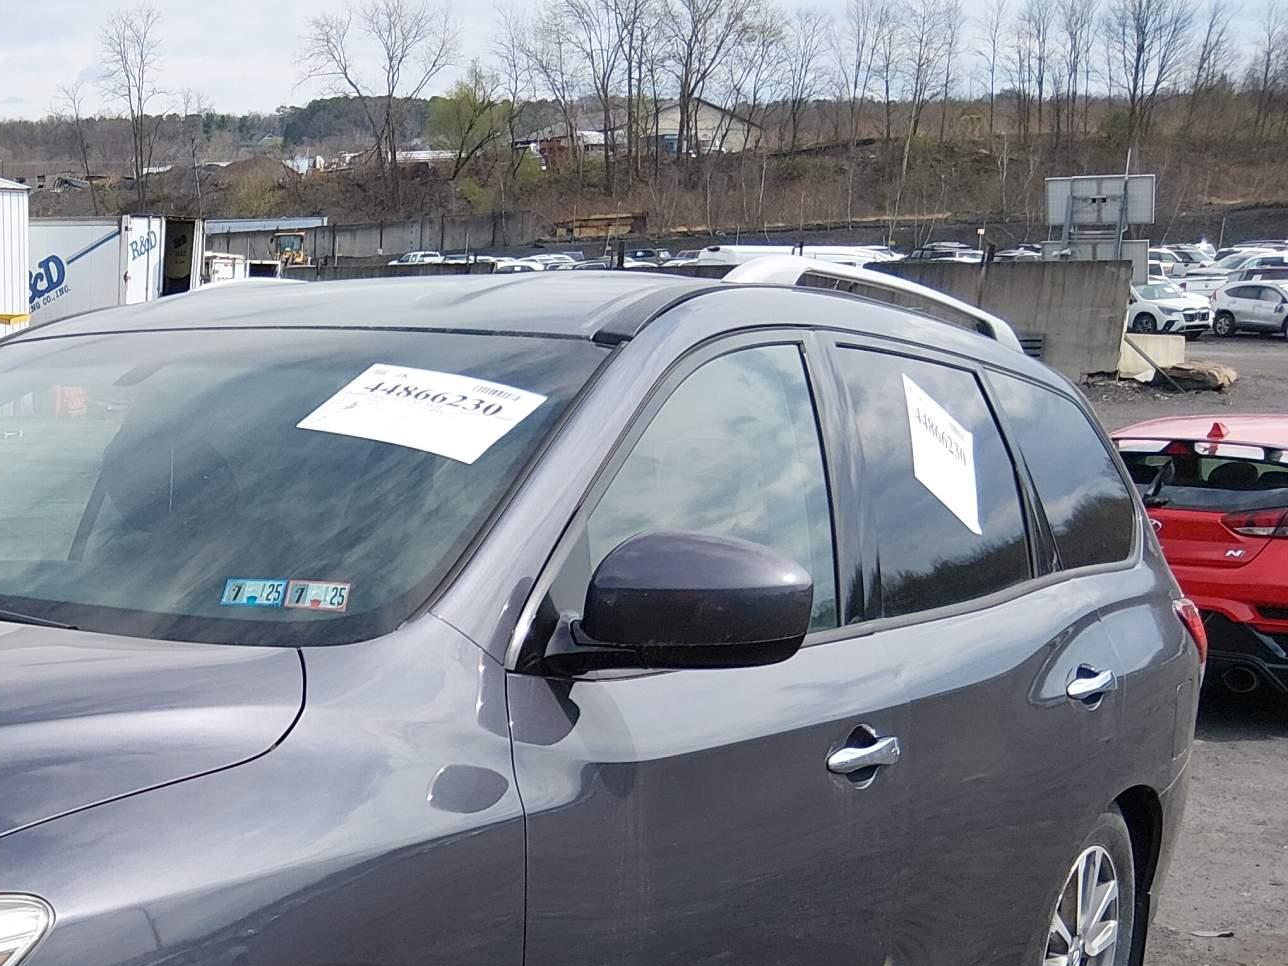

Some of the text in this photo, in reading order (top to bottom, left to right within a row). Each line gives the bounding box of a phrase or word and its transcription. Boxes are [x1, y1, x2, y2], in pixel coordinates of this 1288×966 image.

[129, 230, 158, 262] R&D
[364, 381, 504, 417] 44866230
[231, 583, 283, 602] 7 25
[294, 586, 348, 606] 7 25
